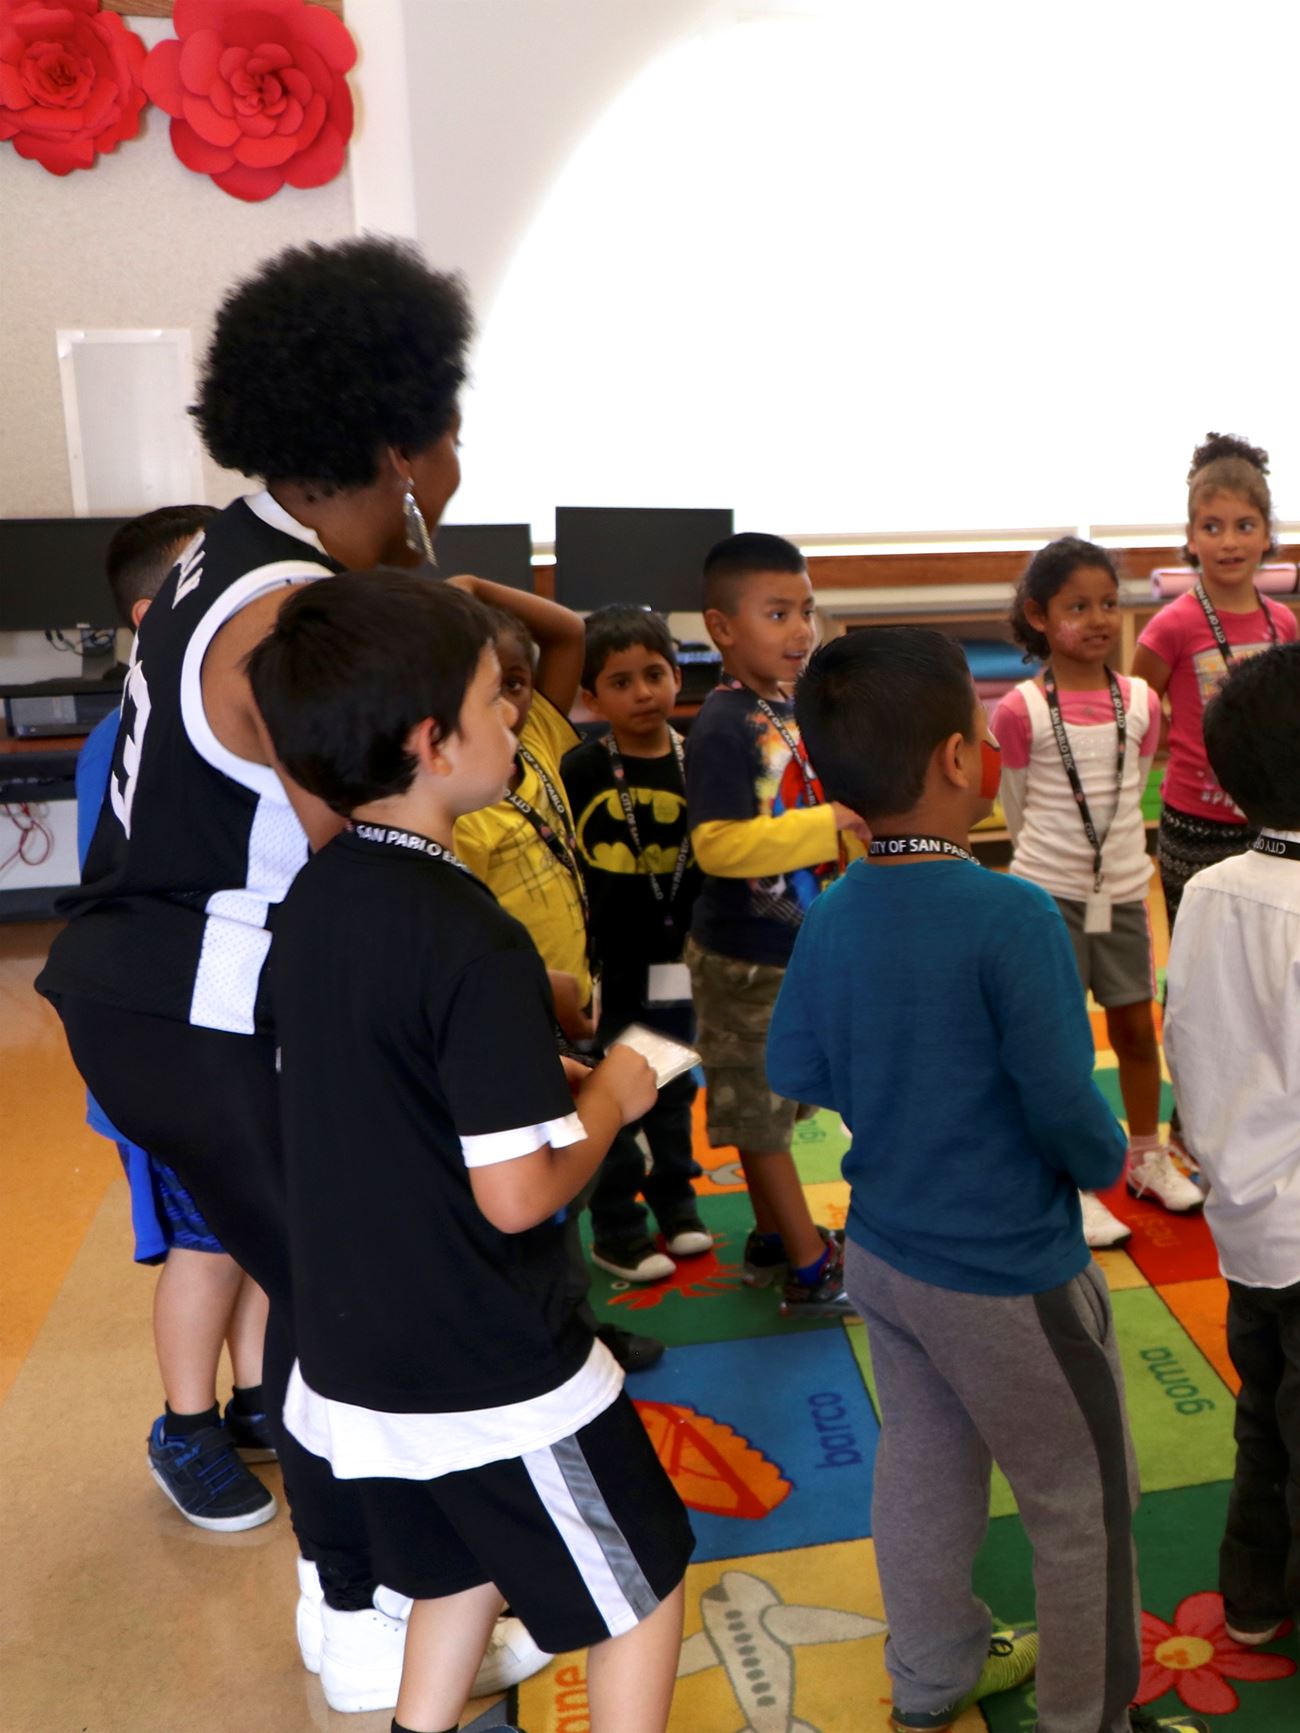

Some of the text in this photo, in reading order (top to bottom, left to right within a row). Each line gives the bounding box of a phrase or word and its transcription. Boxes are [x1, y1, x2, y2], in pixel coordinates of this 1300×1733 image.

[356, 824, 386, 843] SAN
[385, 830, 443, 857] PABLO
[887, 839, 908, 854] OF
[909, 838, 942, 853] SAN
[1264, 840, 1287, 855] CITY
[1140, 1347, 1217, 1416] goma
[808, 1390, 864, 1471] barco
